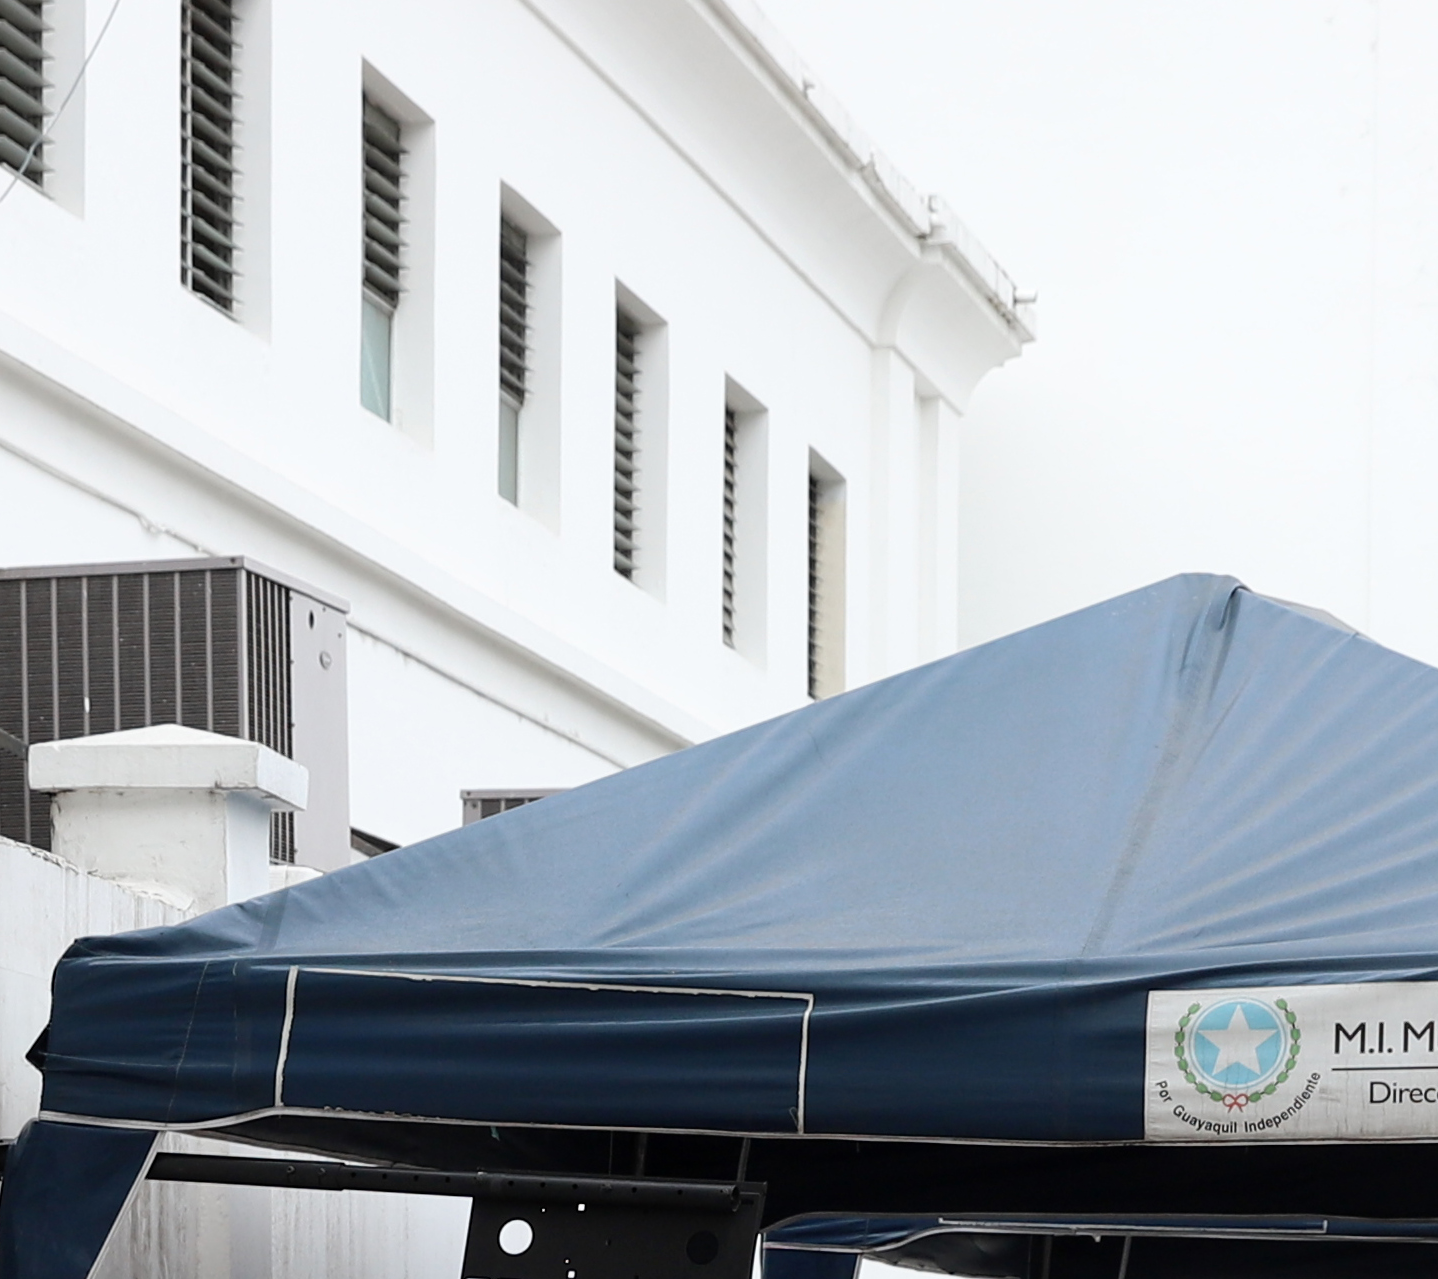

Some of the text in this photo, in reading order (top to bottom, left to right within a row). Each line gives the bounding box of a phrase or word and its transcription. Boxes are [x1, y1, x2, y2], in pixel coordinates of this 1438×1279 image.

[1332, 1022, 1394, 1056] M.I.
[1156, 1072, 1321, 1135] Por Guayaquil Independiente
